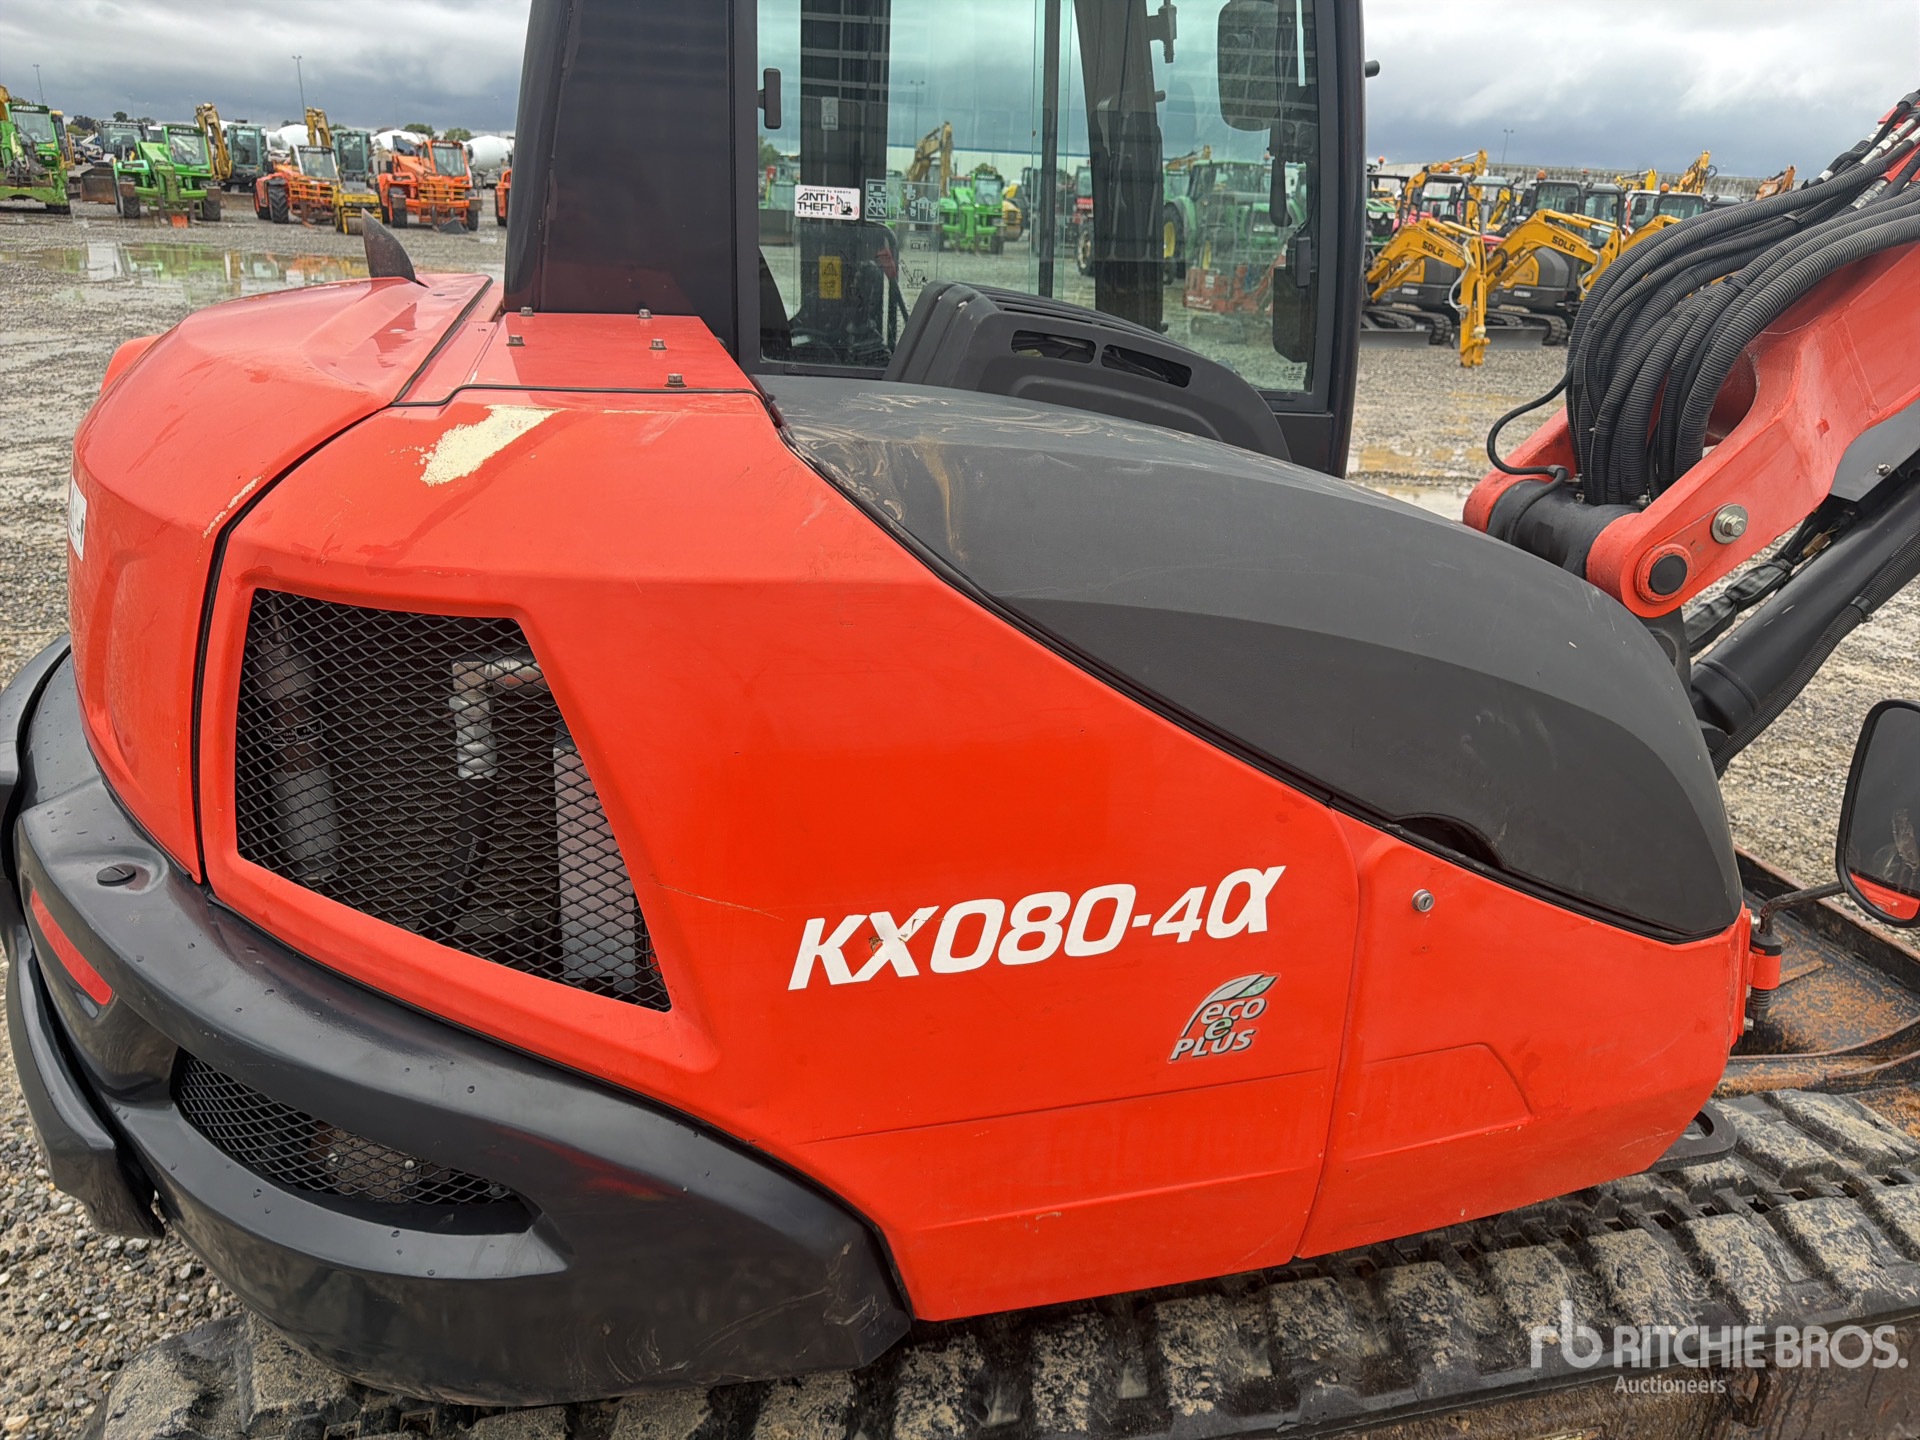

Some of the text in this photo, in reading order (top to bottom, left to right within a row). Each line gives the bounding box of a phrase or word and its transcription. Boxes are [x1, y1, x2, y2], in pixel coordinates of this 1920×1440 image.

[797, 192, 829, 202] ANTI
[796, 201, 835, 212] THEFT
[1422, 240, 1444, 258] SDLG
[1551, 235, 1576, 253] SDLG
[1200, 998, 1266, 1025] eco
[1170, 1029, 1256, 1060] PLUS
